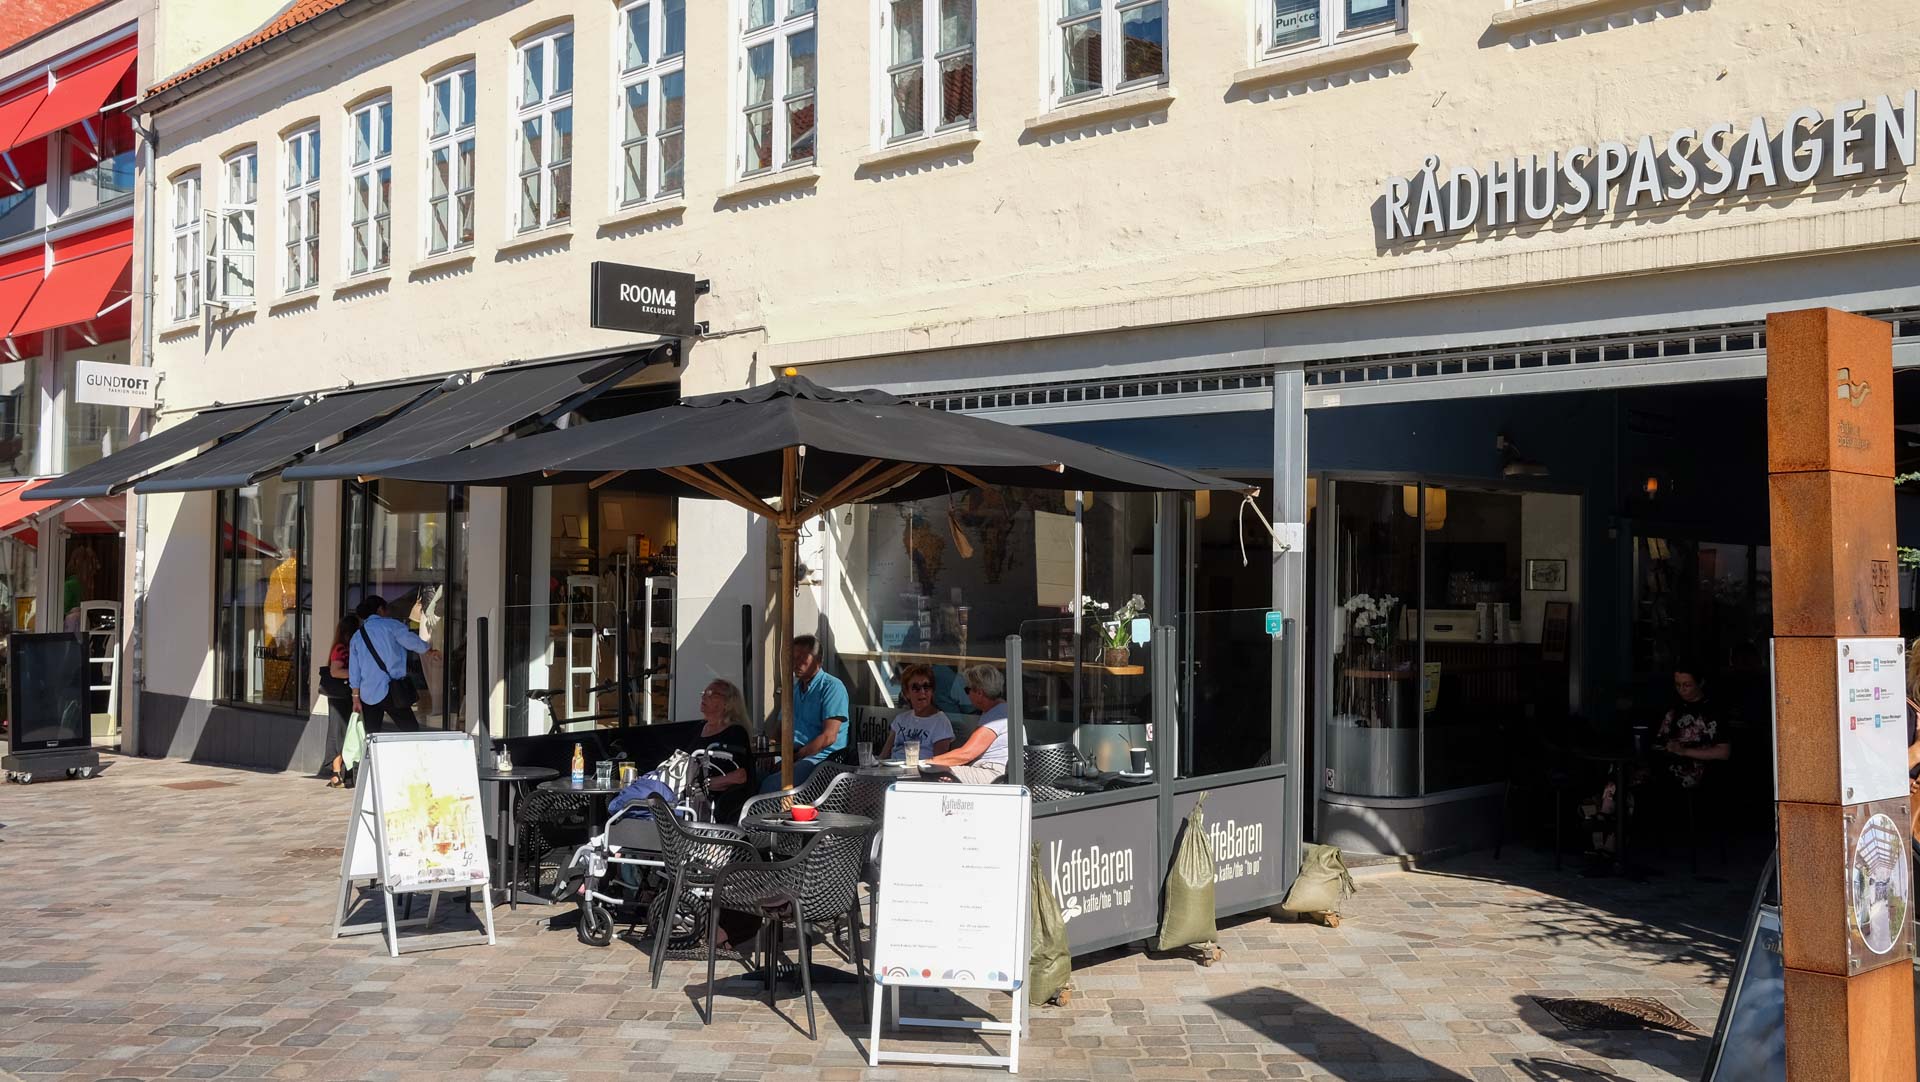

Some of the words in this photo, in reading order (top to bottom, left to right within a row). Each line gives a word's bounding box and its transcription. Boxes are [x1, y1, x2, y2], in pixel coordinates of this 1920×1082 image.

[1275, 11, 1320, 29] Punktet
[1385, 88, 1918, 240] RÅDHUSPASSAGEN
[620, 283, 677, 307] ROOM4
[641, 305, 676, 316] EXCLUSIVE
[86, 374, 149, 390] GUNDTOFT
[1206, 819, 1263, 862] ffeBaren
[1050, 839, 1133, 909] KaffeBaren
[1082, 891, 1112, 914] kaffe/the
